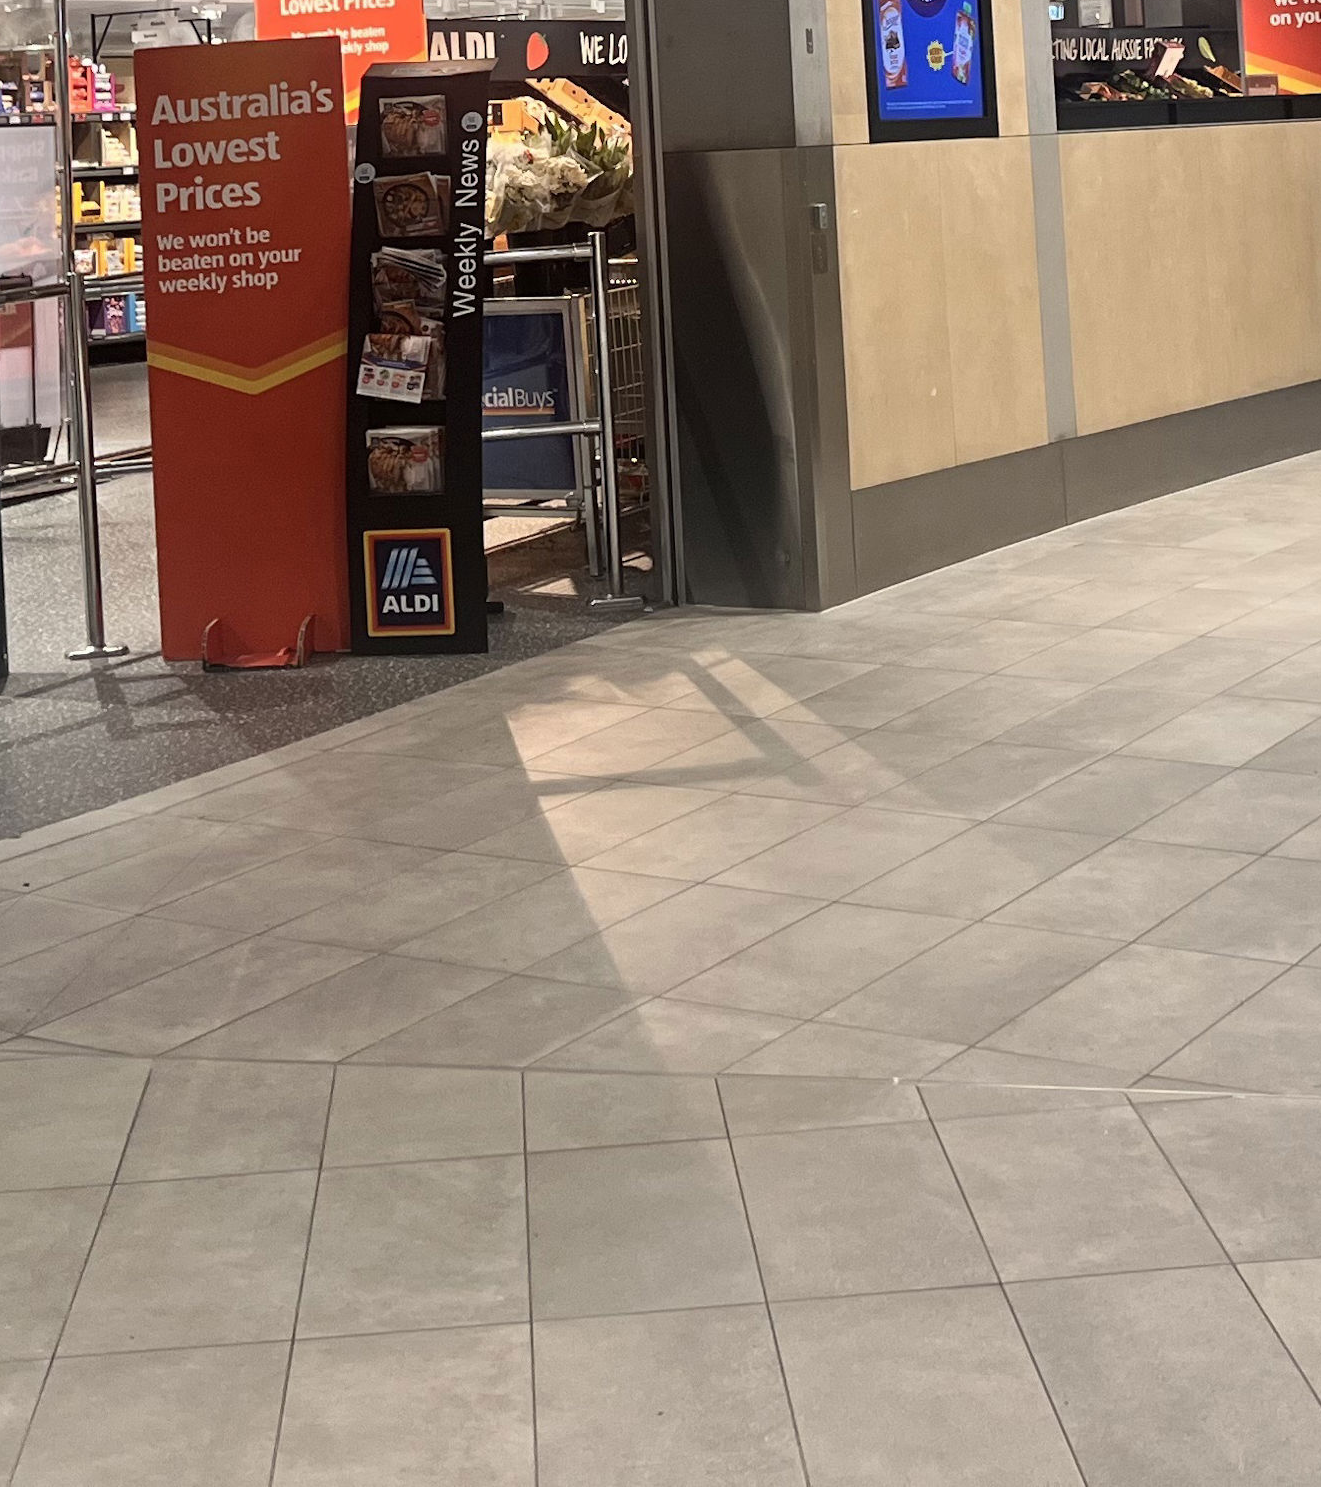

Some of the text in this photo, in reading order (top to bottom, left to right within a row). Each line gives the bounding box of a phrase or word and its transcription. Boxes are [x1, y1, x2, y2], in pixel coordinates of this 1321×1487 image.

[1269, 12, 1292, 26] on
[350, 26, 385, 39] beaten
[365, 39, 390, 57] shop
[429, 31, 496, 62] ALDI
[579, 31, 605, 65] WE
[1051, 37, 1078, 61] TING
[1079, 36, 1109, 62] LOCAL
[1111, 37, 1143, 61] AUSSIE
[151, 80, 334, 126] Australia's
[154, 131, 281, 169] Lowest
[454, 138, 480, 208] News
[156, 175, 261, 213] Prices
[157, 226, 270, 251] We won't be
[158, 247, 302, 272] beaten on your
[452, 222, 483, 318] Weekly
[158, 269, 278, 294] weekly shop
[482, 386, 555, 412] cialBuys
[381, 593, 439, 614] ALDI
